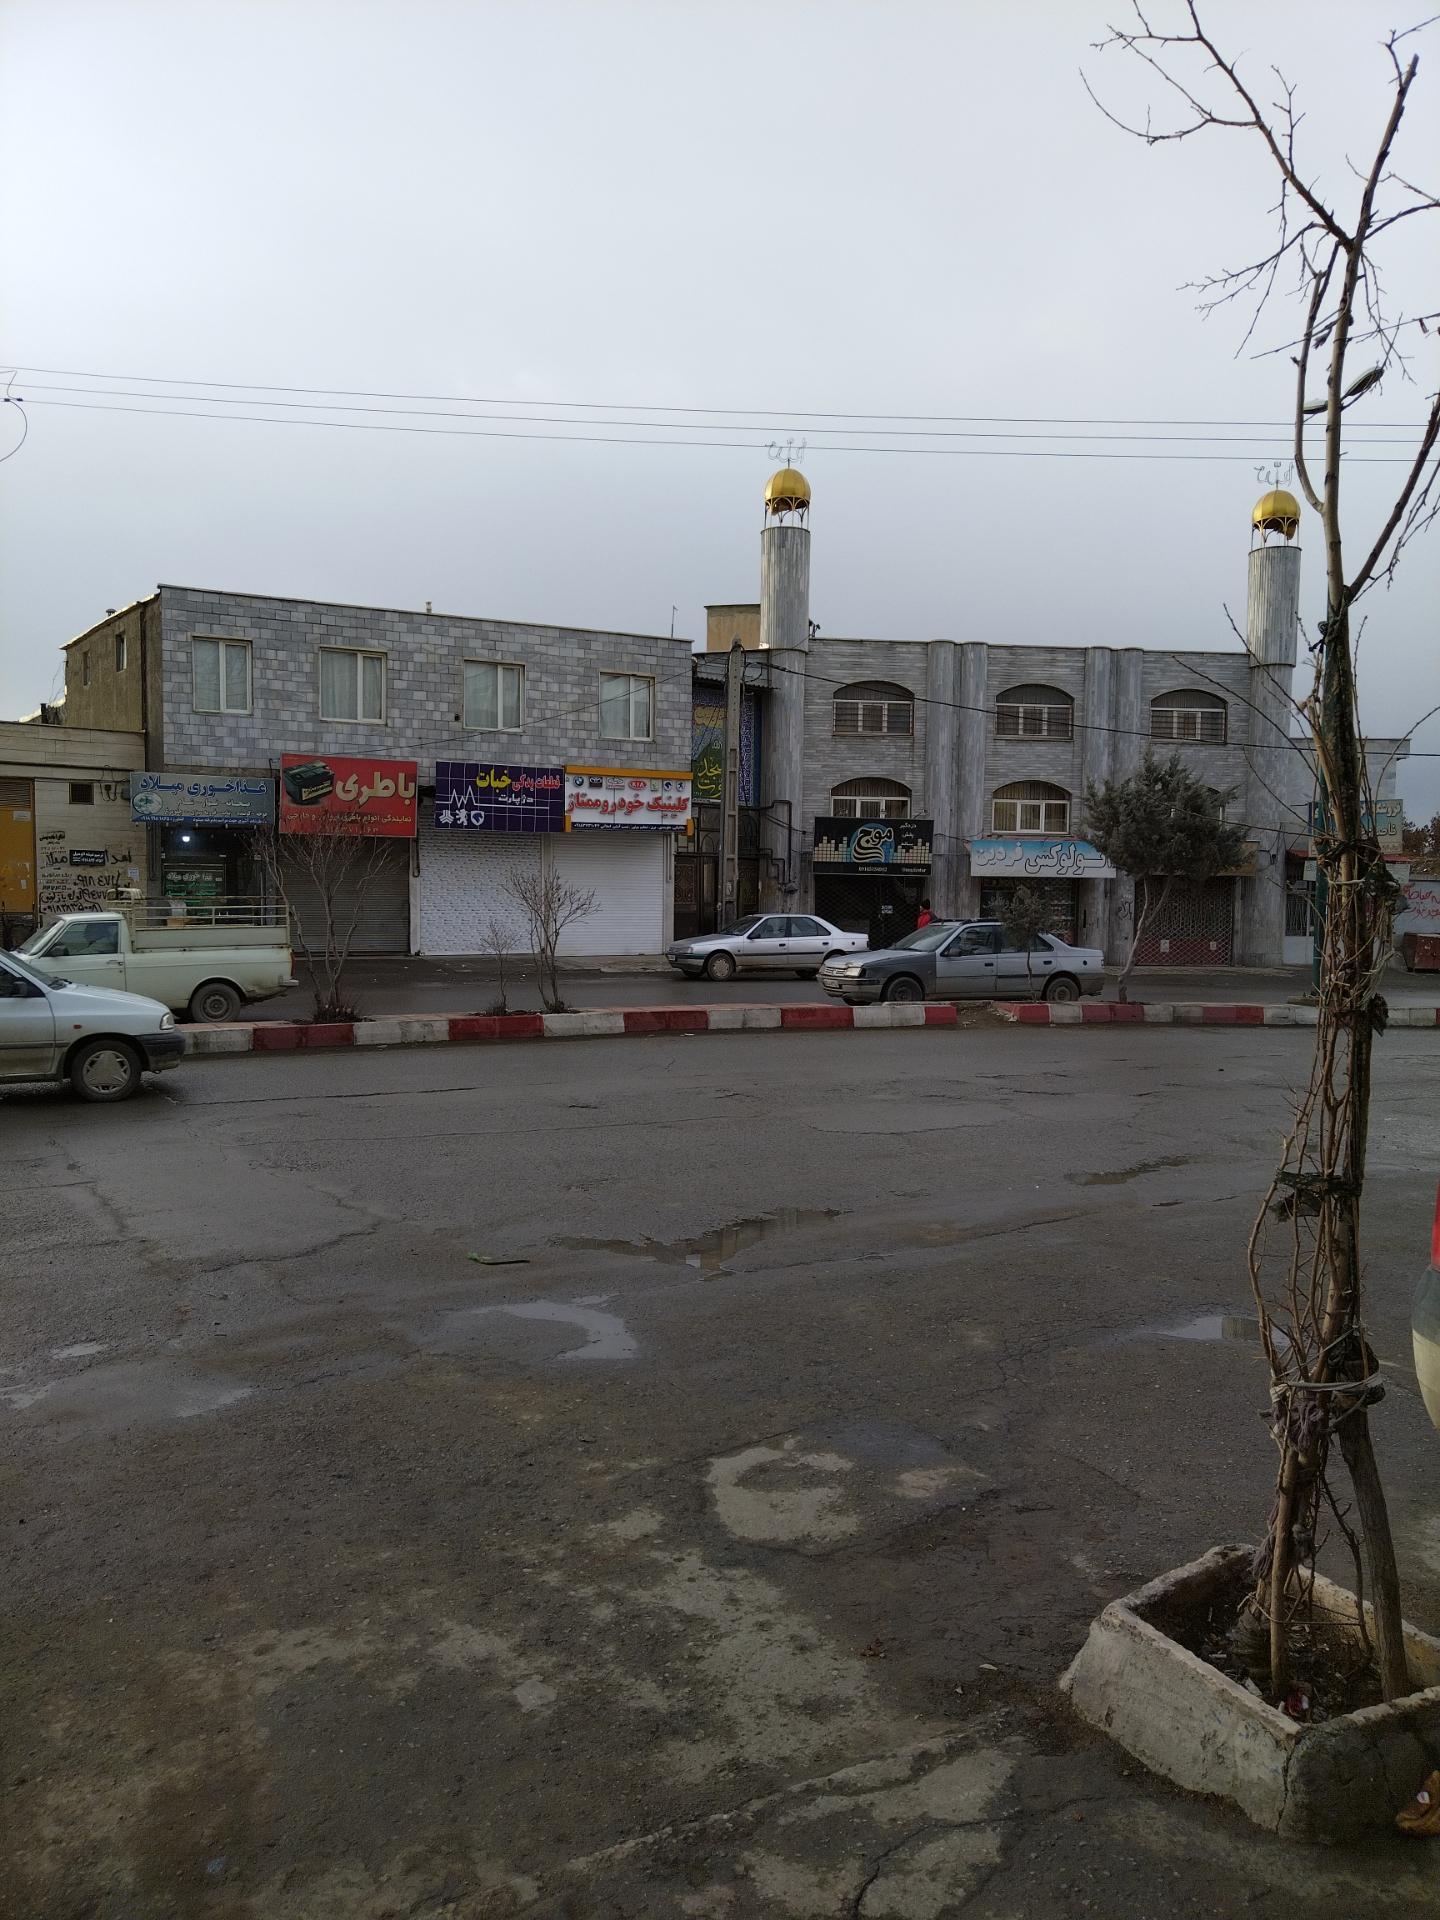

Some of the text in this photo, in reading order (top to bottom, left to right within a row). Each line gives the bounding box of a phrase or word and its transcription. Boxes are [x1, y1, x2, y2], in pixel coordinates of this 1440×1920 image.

[139, 775, 184, 795] میلاد
[335, 771, 416, 806] باطری
[476, 768, 561, 793] قطعات یدکی خبات
[382, 814, 412, 823] نمایندگی
[647, 795, 690, 819] کلینیک
[852, 827, 894, 861] موج
[976, 841, 1023, 867] فردین
